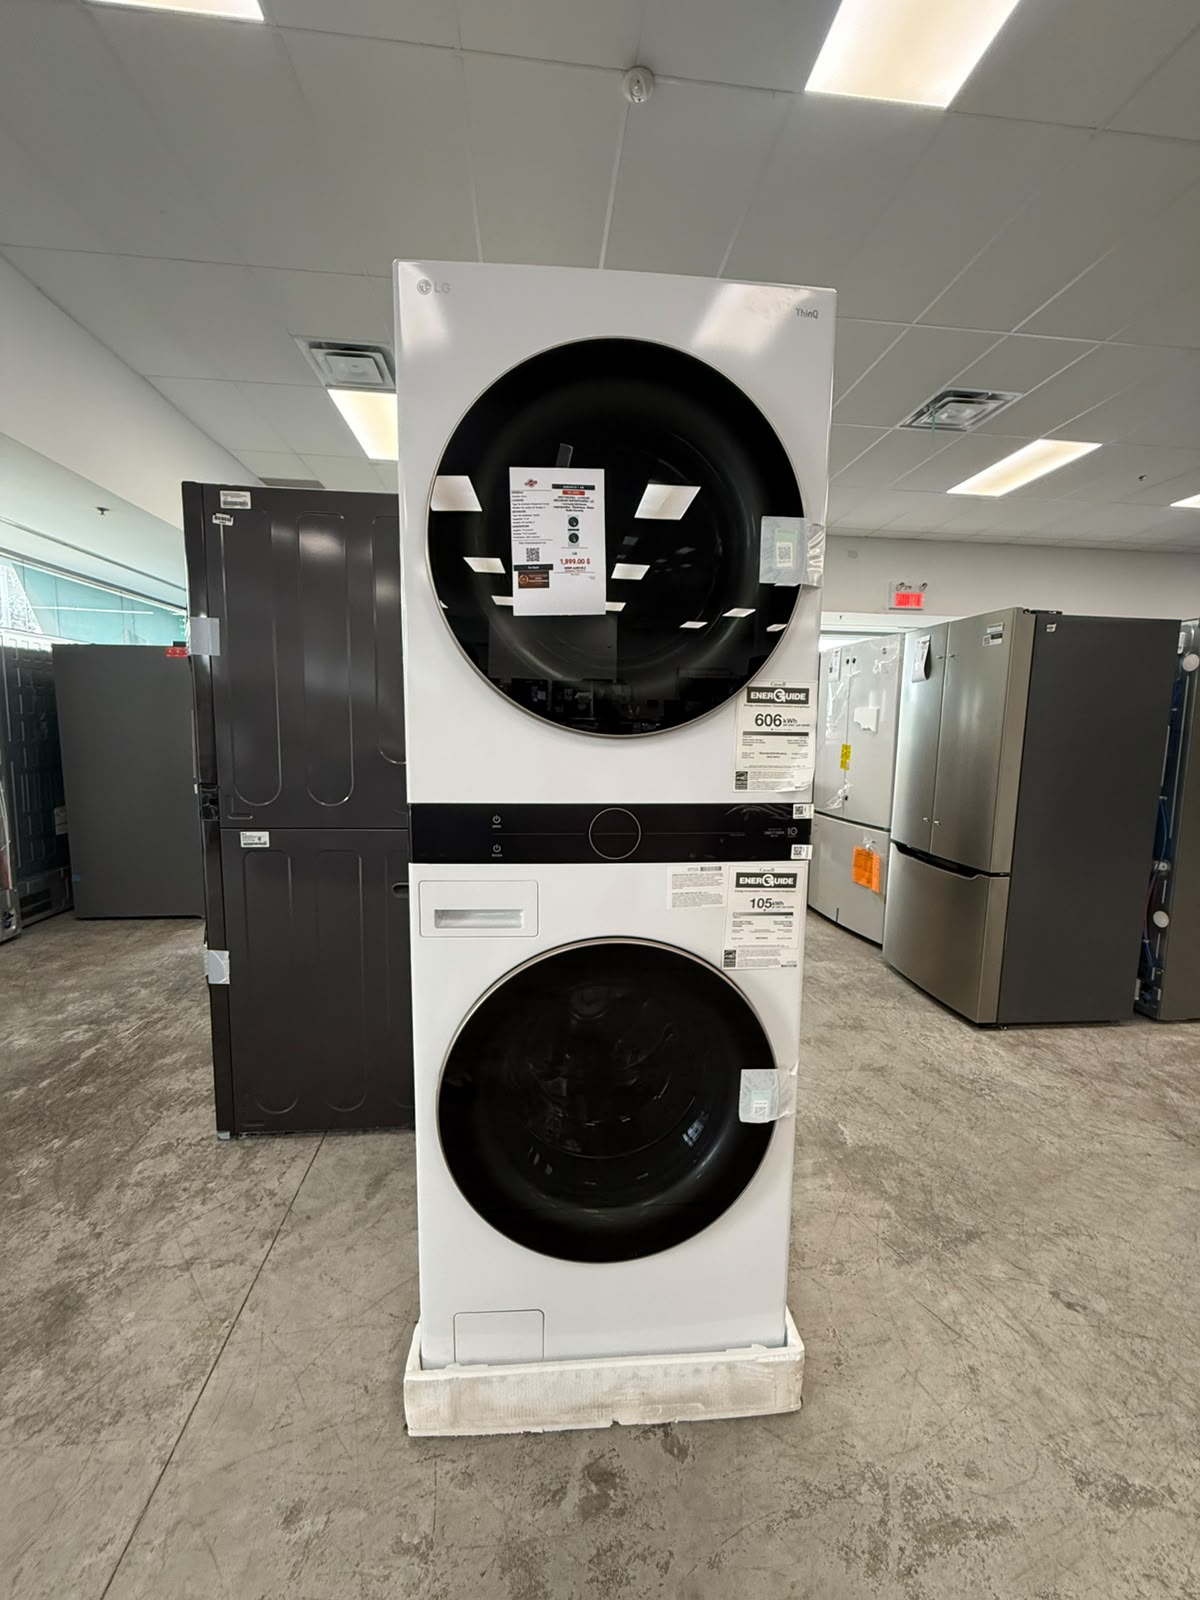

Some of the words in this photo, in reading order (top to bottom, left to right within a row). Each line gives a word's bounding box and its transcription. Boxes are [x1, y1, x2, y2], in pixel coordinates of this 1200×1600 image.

[795, 307, 819, 320] ThinQ
[586, 557, 591, 565] $
[750, 688, 807, 703] ENERGUIDE
[755, 713, 782, 727] 606
[739, 873, 795, 887] ENERGUIDE
[749, 898, 773, 909] 105
